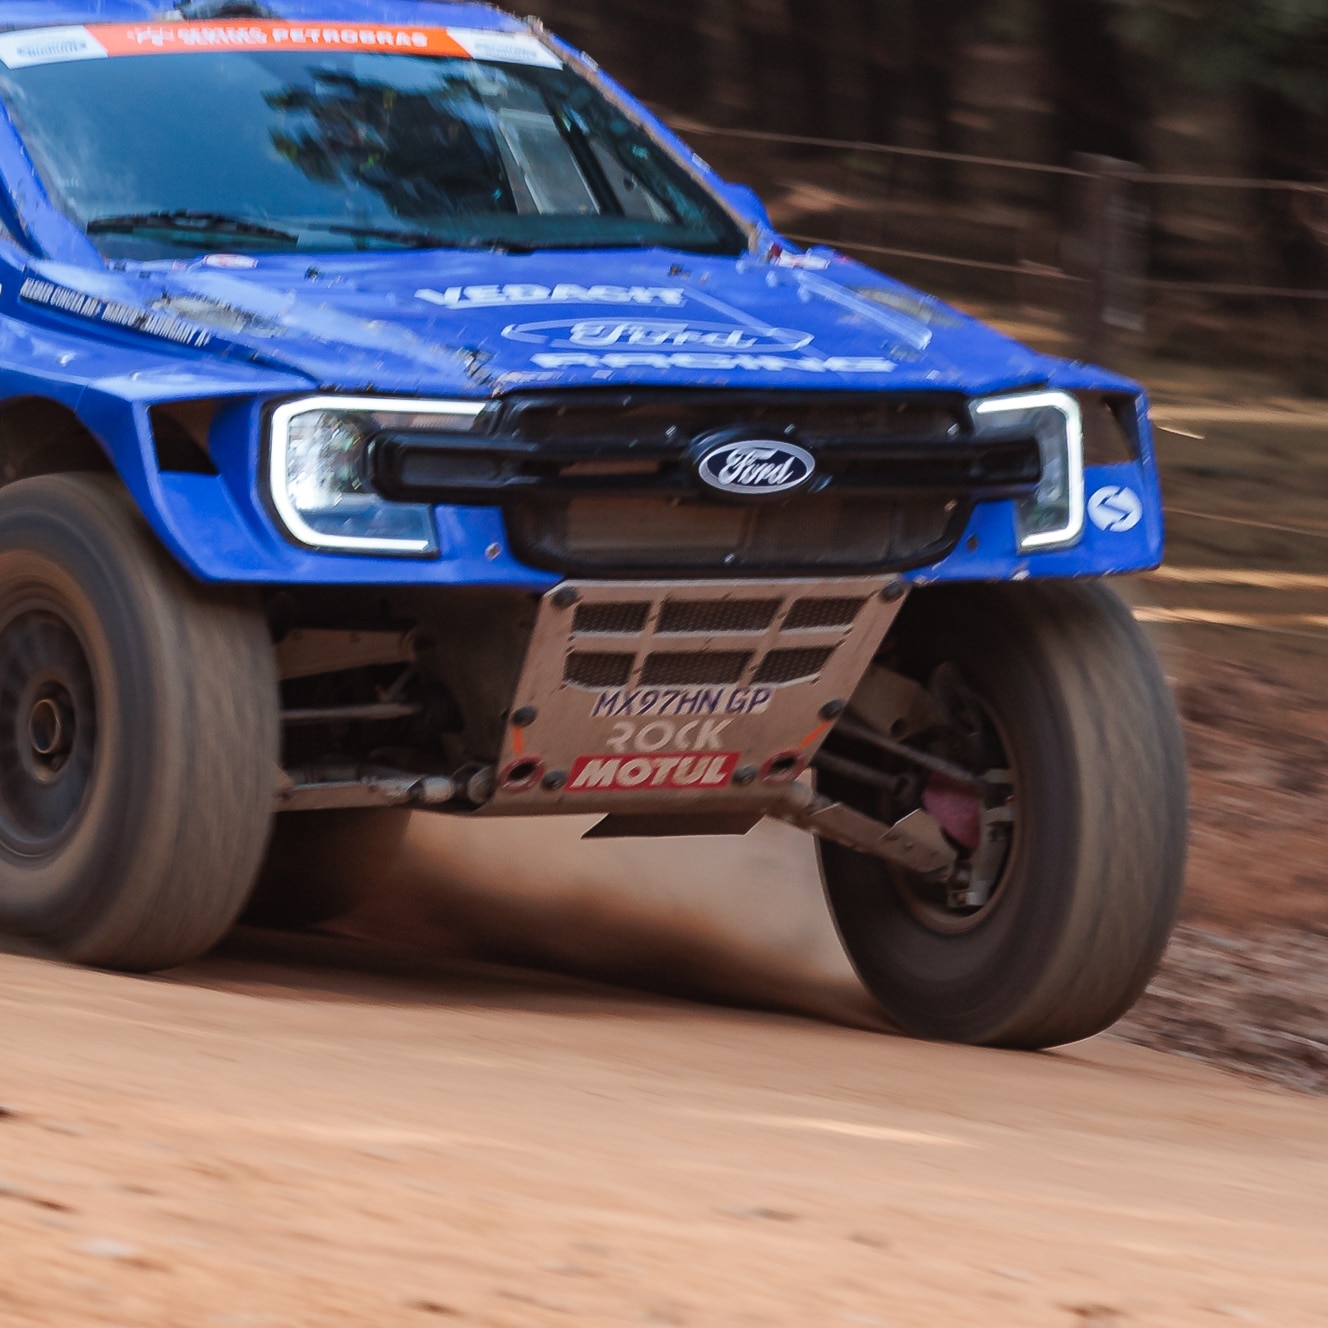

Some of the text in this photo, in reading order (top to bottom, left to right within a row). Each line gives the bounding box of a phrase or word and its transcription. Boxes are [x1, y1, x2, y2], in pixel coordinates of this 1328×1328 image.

[272, 27, 428, 48] PETROBRAS
[570, 322, 757, 348] Ford
[717, 448, 795, 485] Ford
[725, 686, 772, 715] GP
[569, 754, 729, 788] MOTUL
